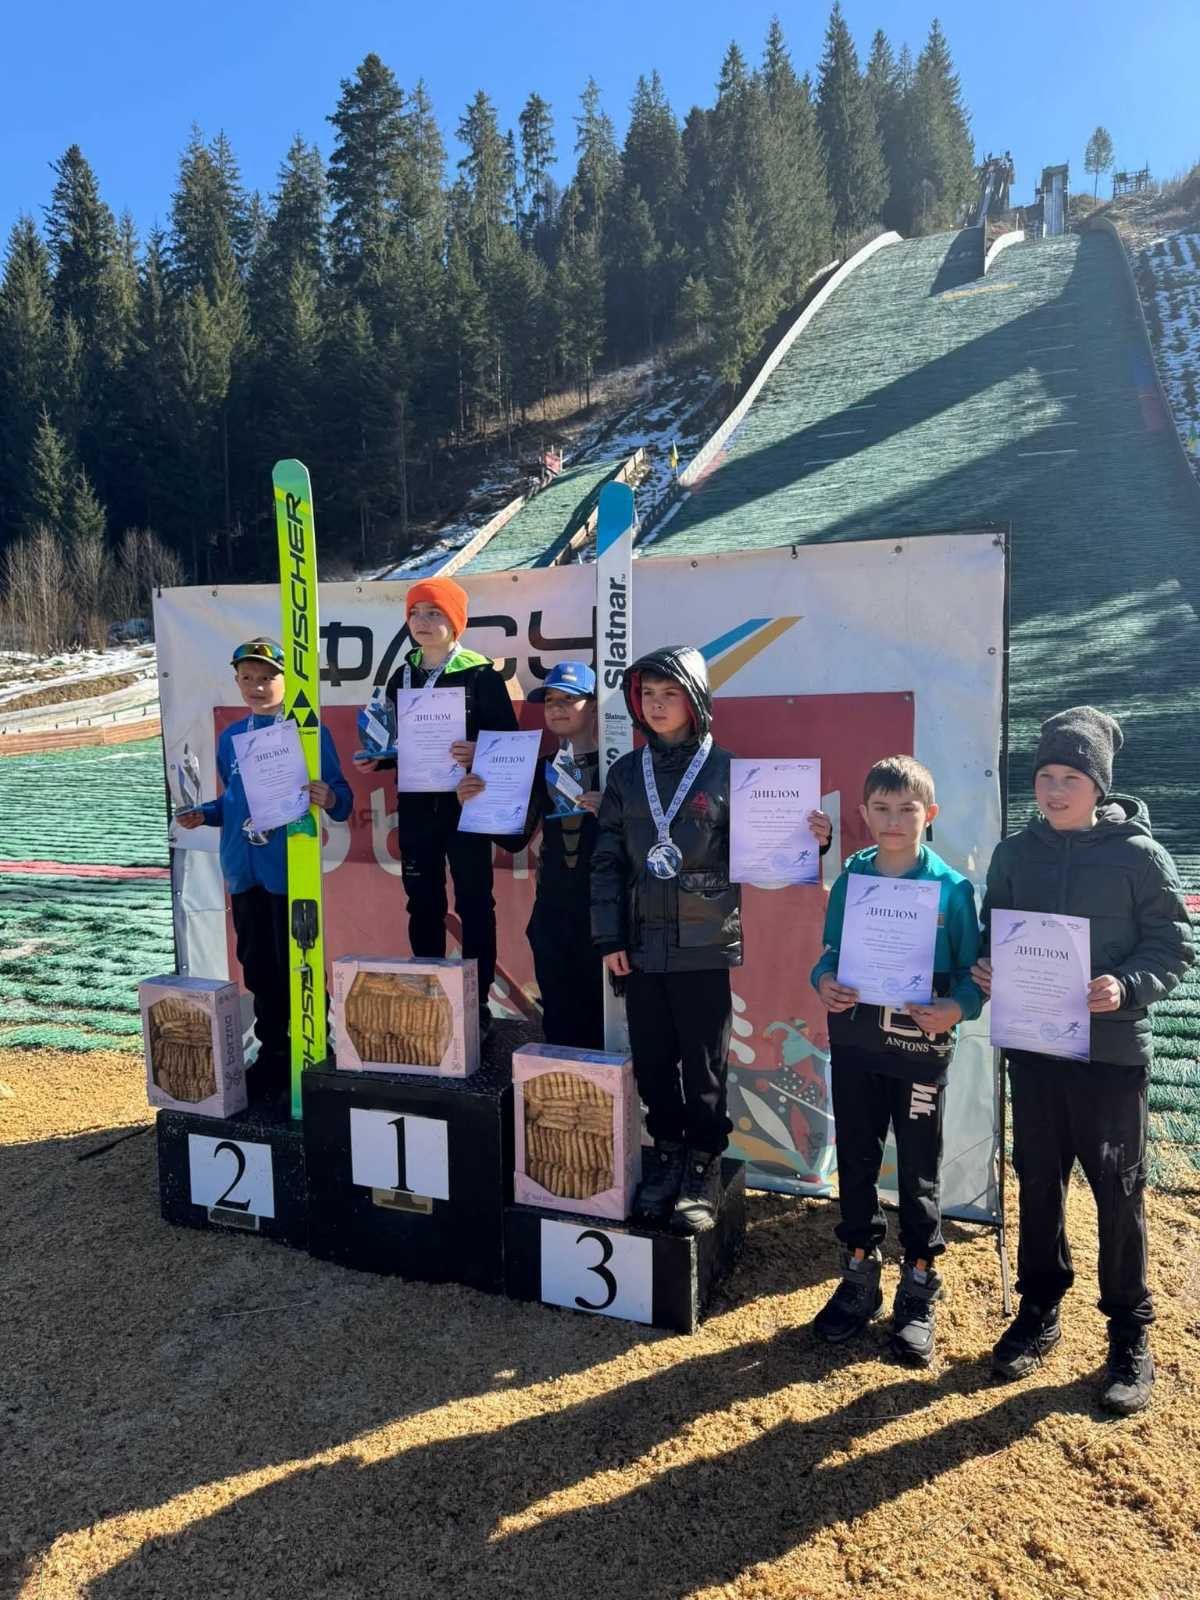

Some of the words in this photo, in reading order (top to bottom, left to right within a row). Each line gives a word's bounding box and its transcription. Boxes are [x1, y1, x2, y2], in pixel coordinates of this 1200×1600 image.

[286, 491, 309, 681] FISCHER
[604, 577, 627, 691] Slatnar
[750, 789, 799, 800] ДИПЛОМ
[865, 906, 918, 920] ДИПЛОМ
[1014, 944, 1070, 961] ДИПЛОМ
[224, 1014, 236, 1066] borzna
[885, 1036, 930, 1053] ANTONS
[214, 1141, 251, 1211] 2
[387, 1116, 415, 1193] 1
[575, 1230, 618, 1310] 3
